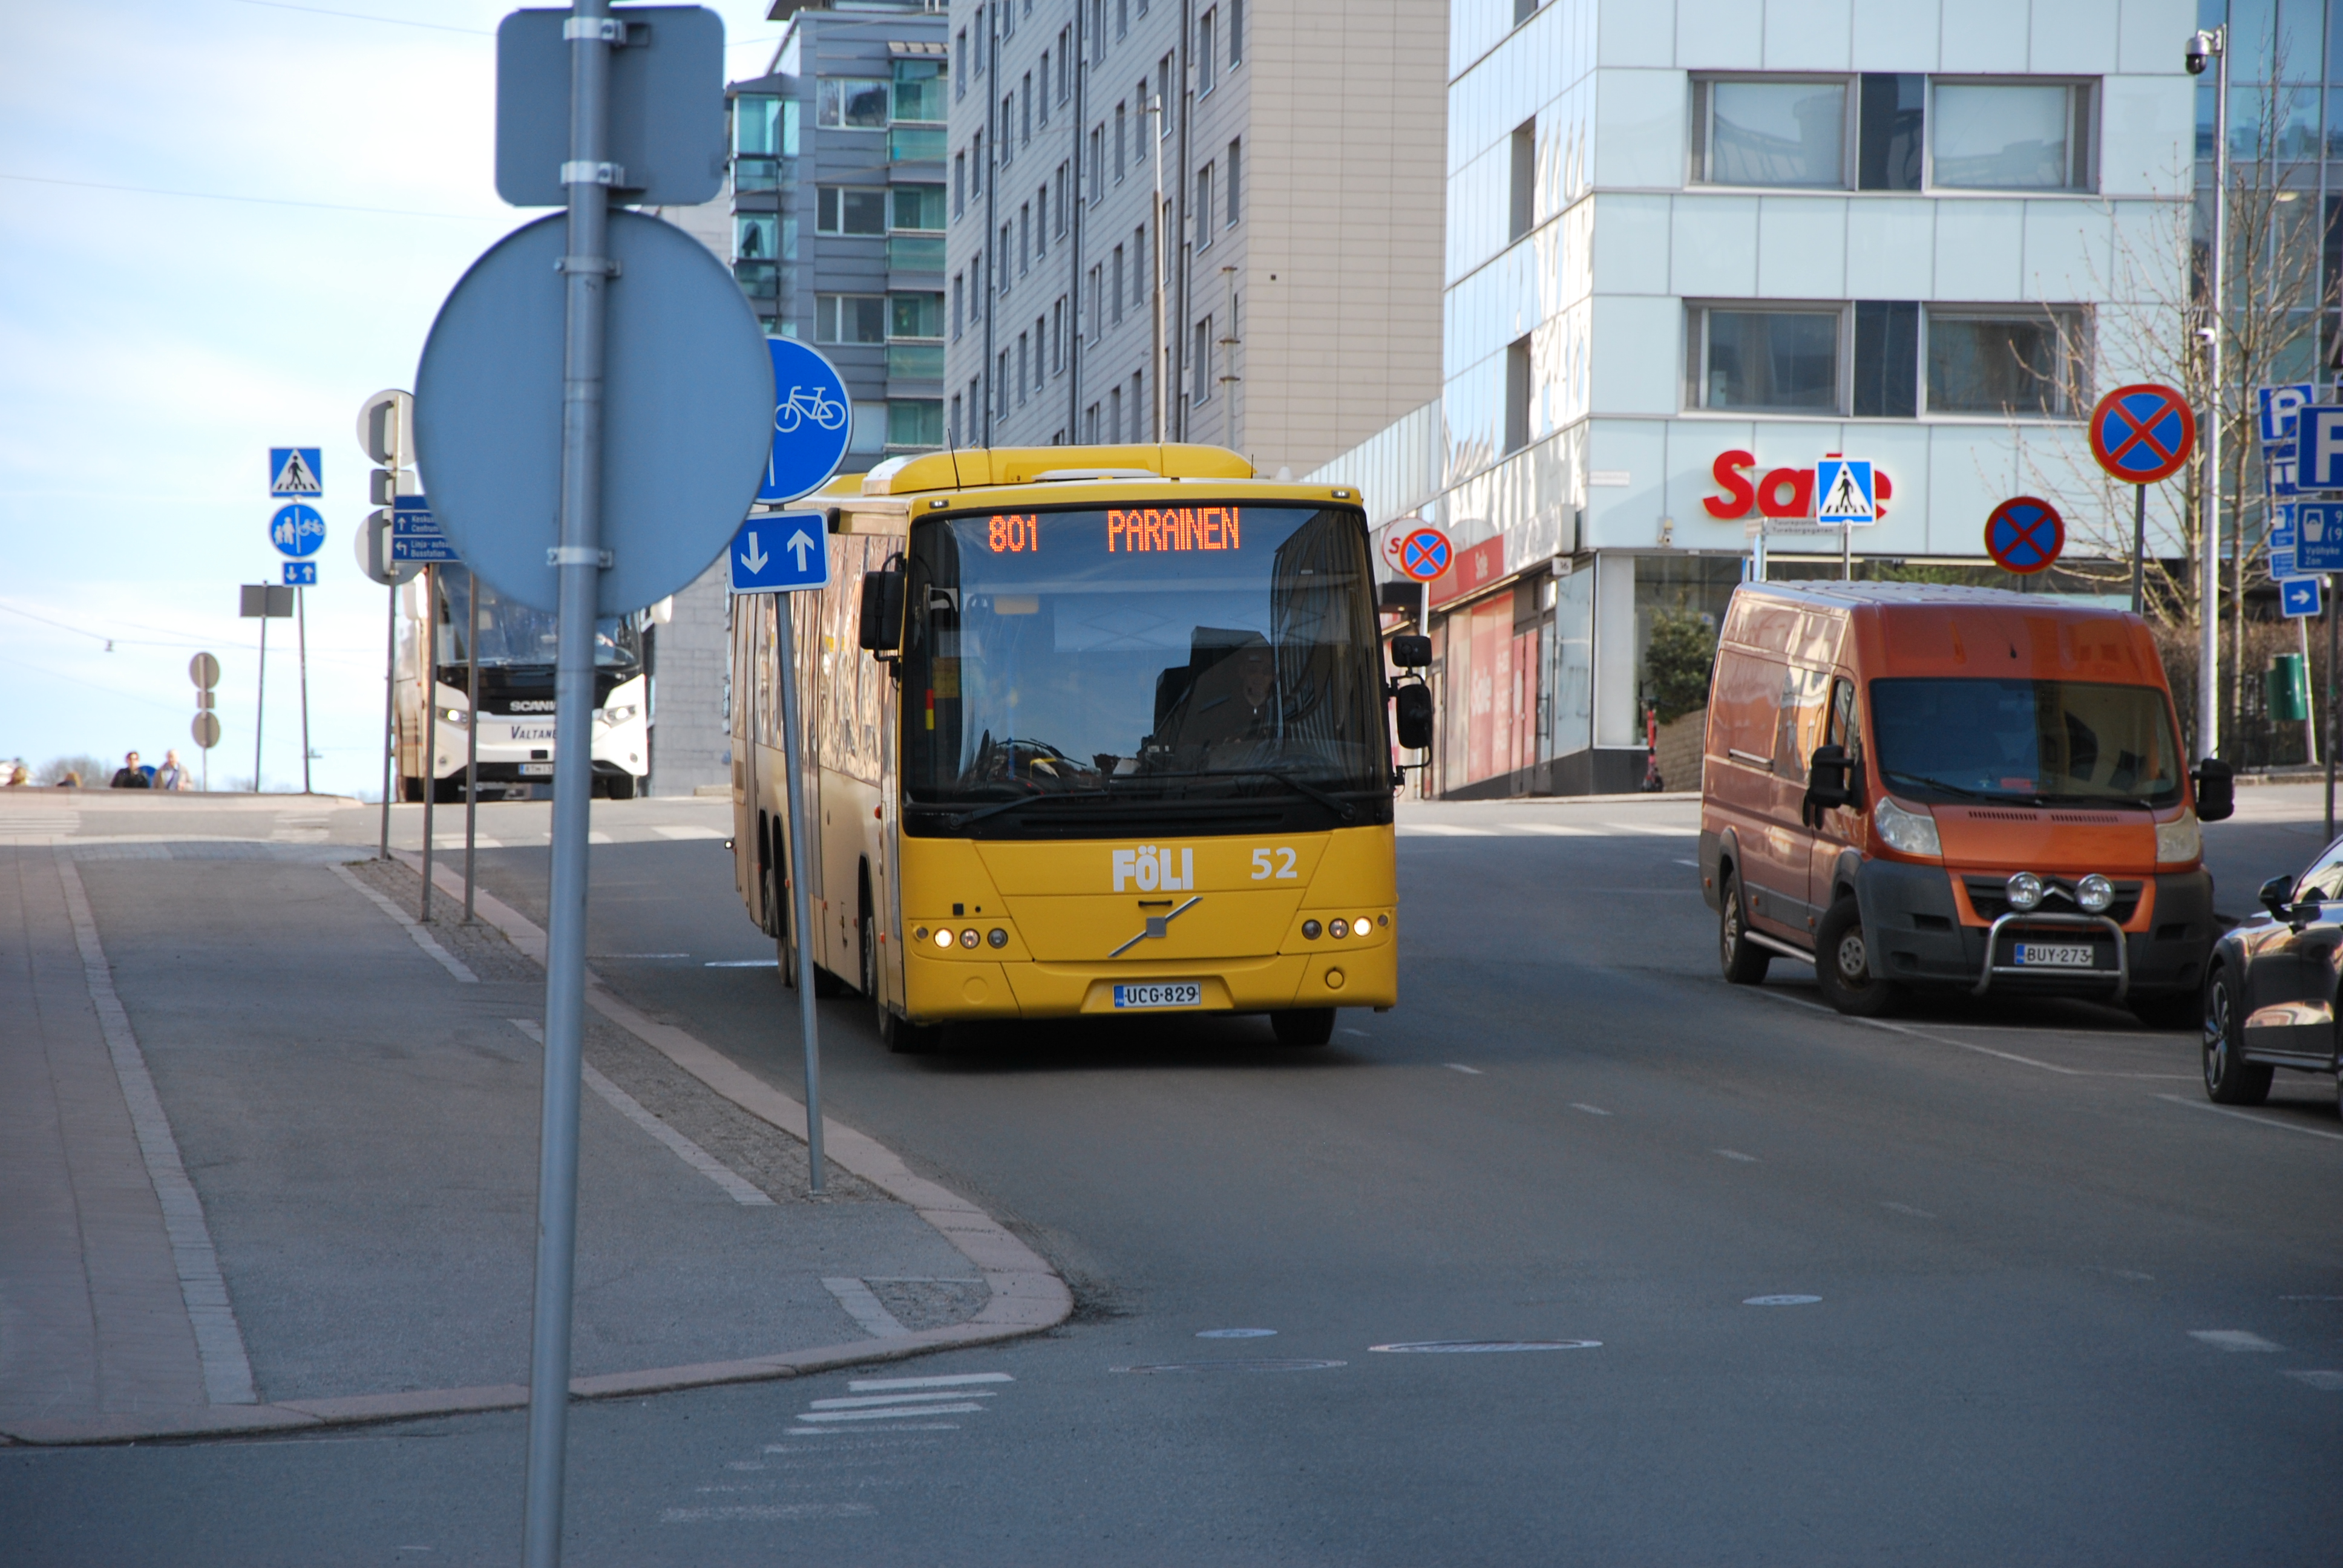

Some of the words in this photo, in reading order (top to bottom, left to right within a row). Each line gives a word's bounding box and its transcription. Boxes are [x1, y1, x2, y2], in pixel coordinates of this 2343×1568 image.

[2270, 388, 2307, 437] P
[1703, 450, 1892, 520] Sa
[989, 515, 1037, 552] 801
[1107, 507, 1240, 552] PARAINEN
[1112, 845, 1193, 892] FÖLI
[1251, 847, 1297, 880] 52
